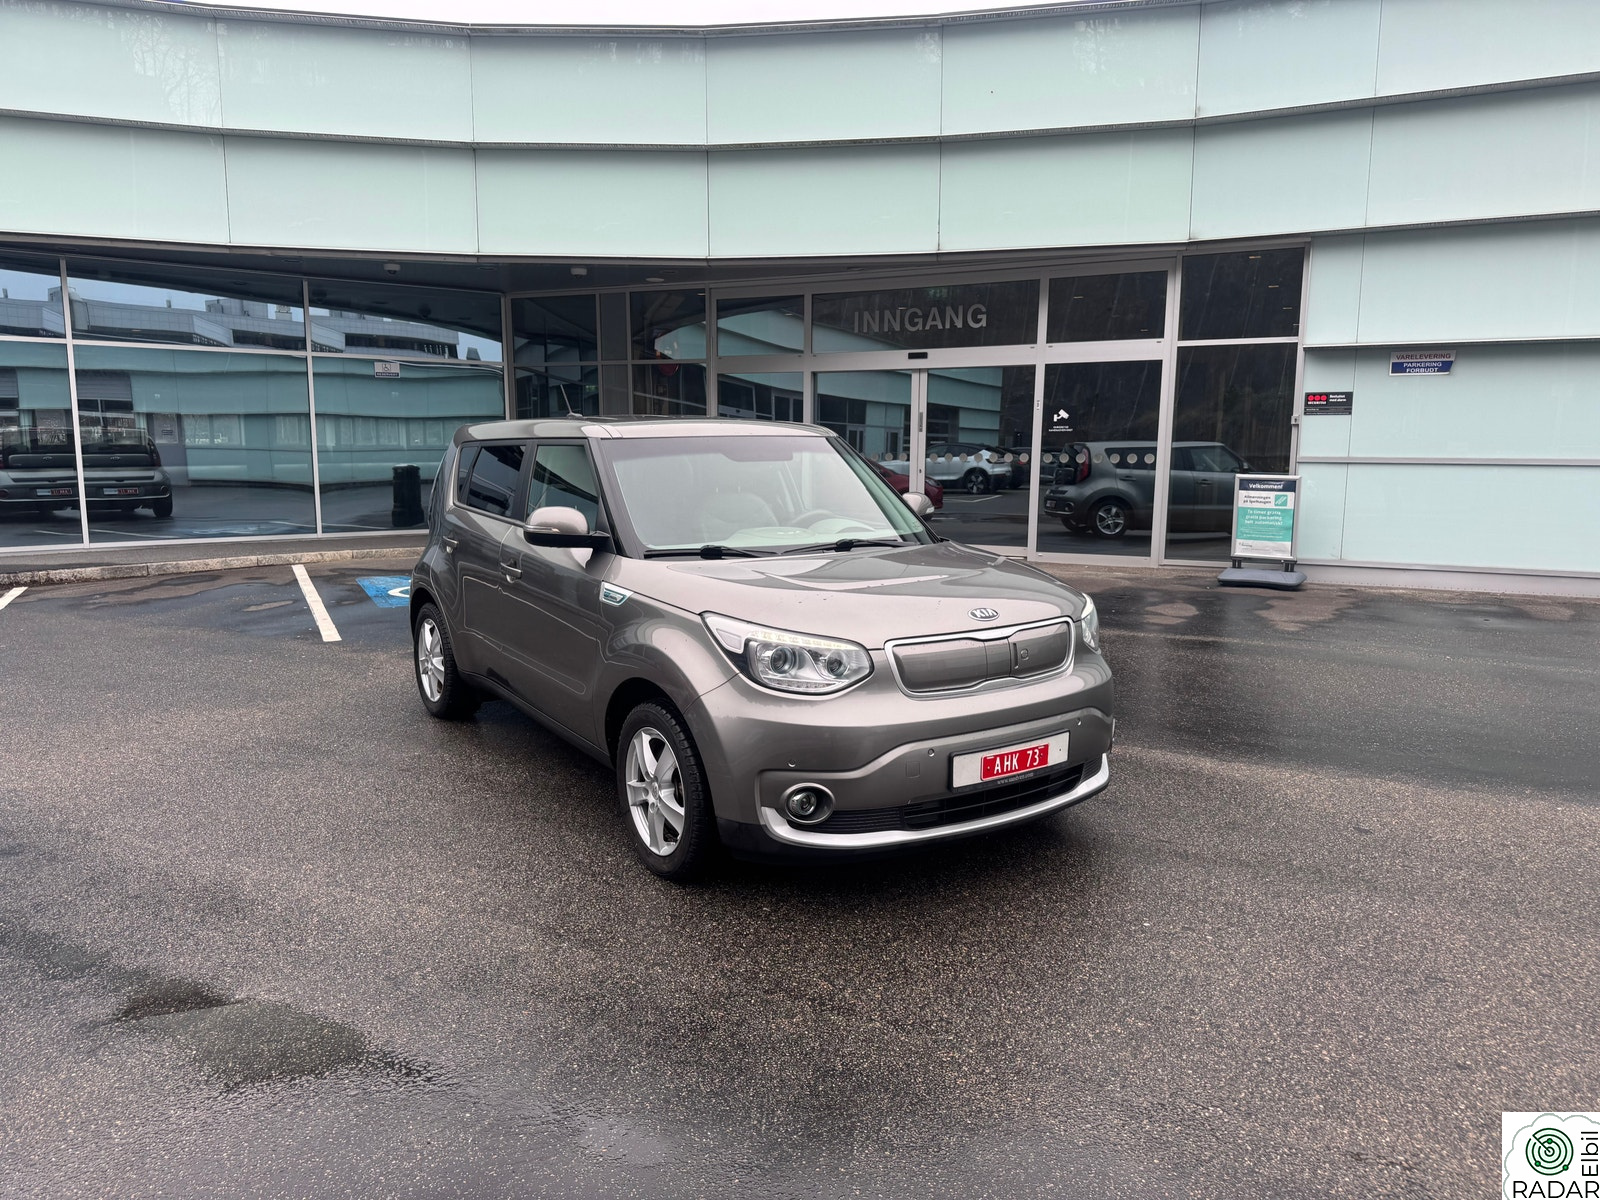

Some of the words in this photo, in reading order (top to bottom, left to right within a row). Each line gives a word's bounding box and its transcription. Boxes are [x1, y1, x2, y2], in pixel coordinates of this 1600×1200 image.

[854, 304, 987, 333] INNGANG
[972, 609, 997, 618] KIA
[993, 752, 1020, 774] AHK
[1026, 748, 1040, 768] 73
